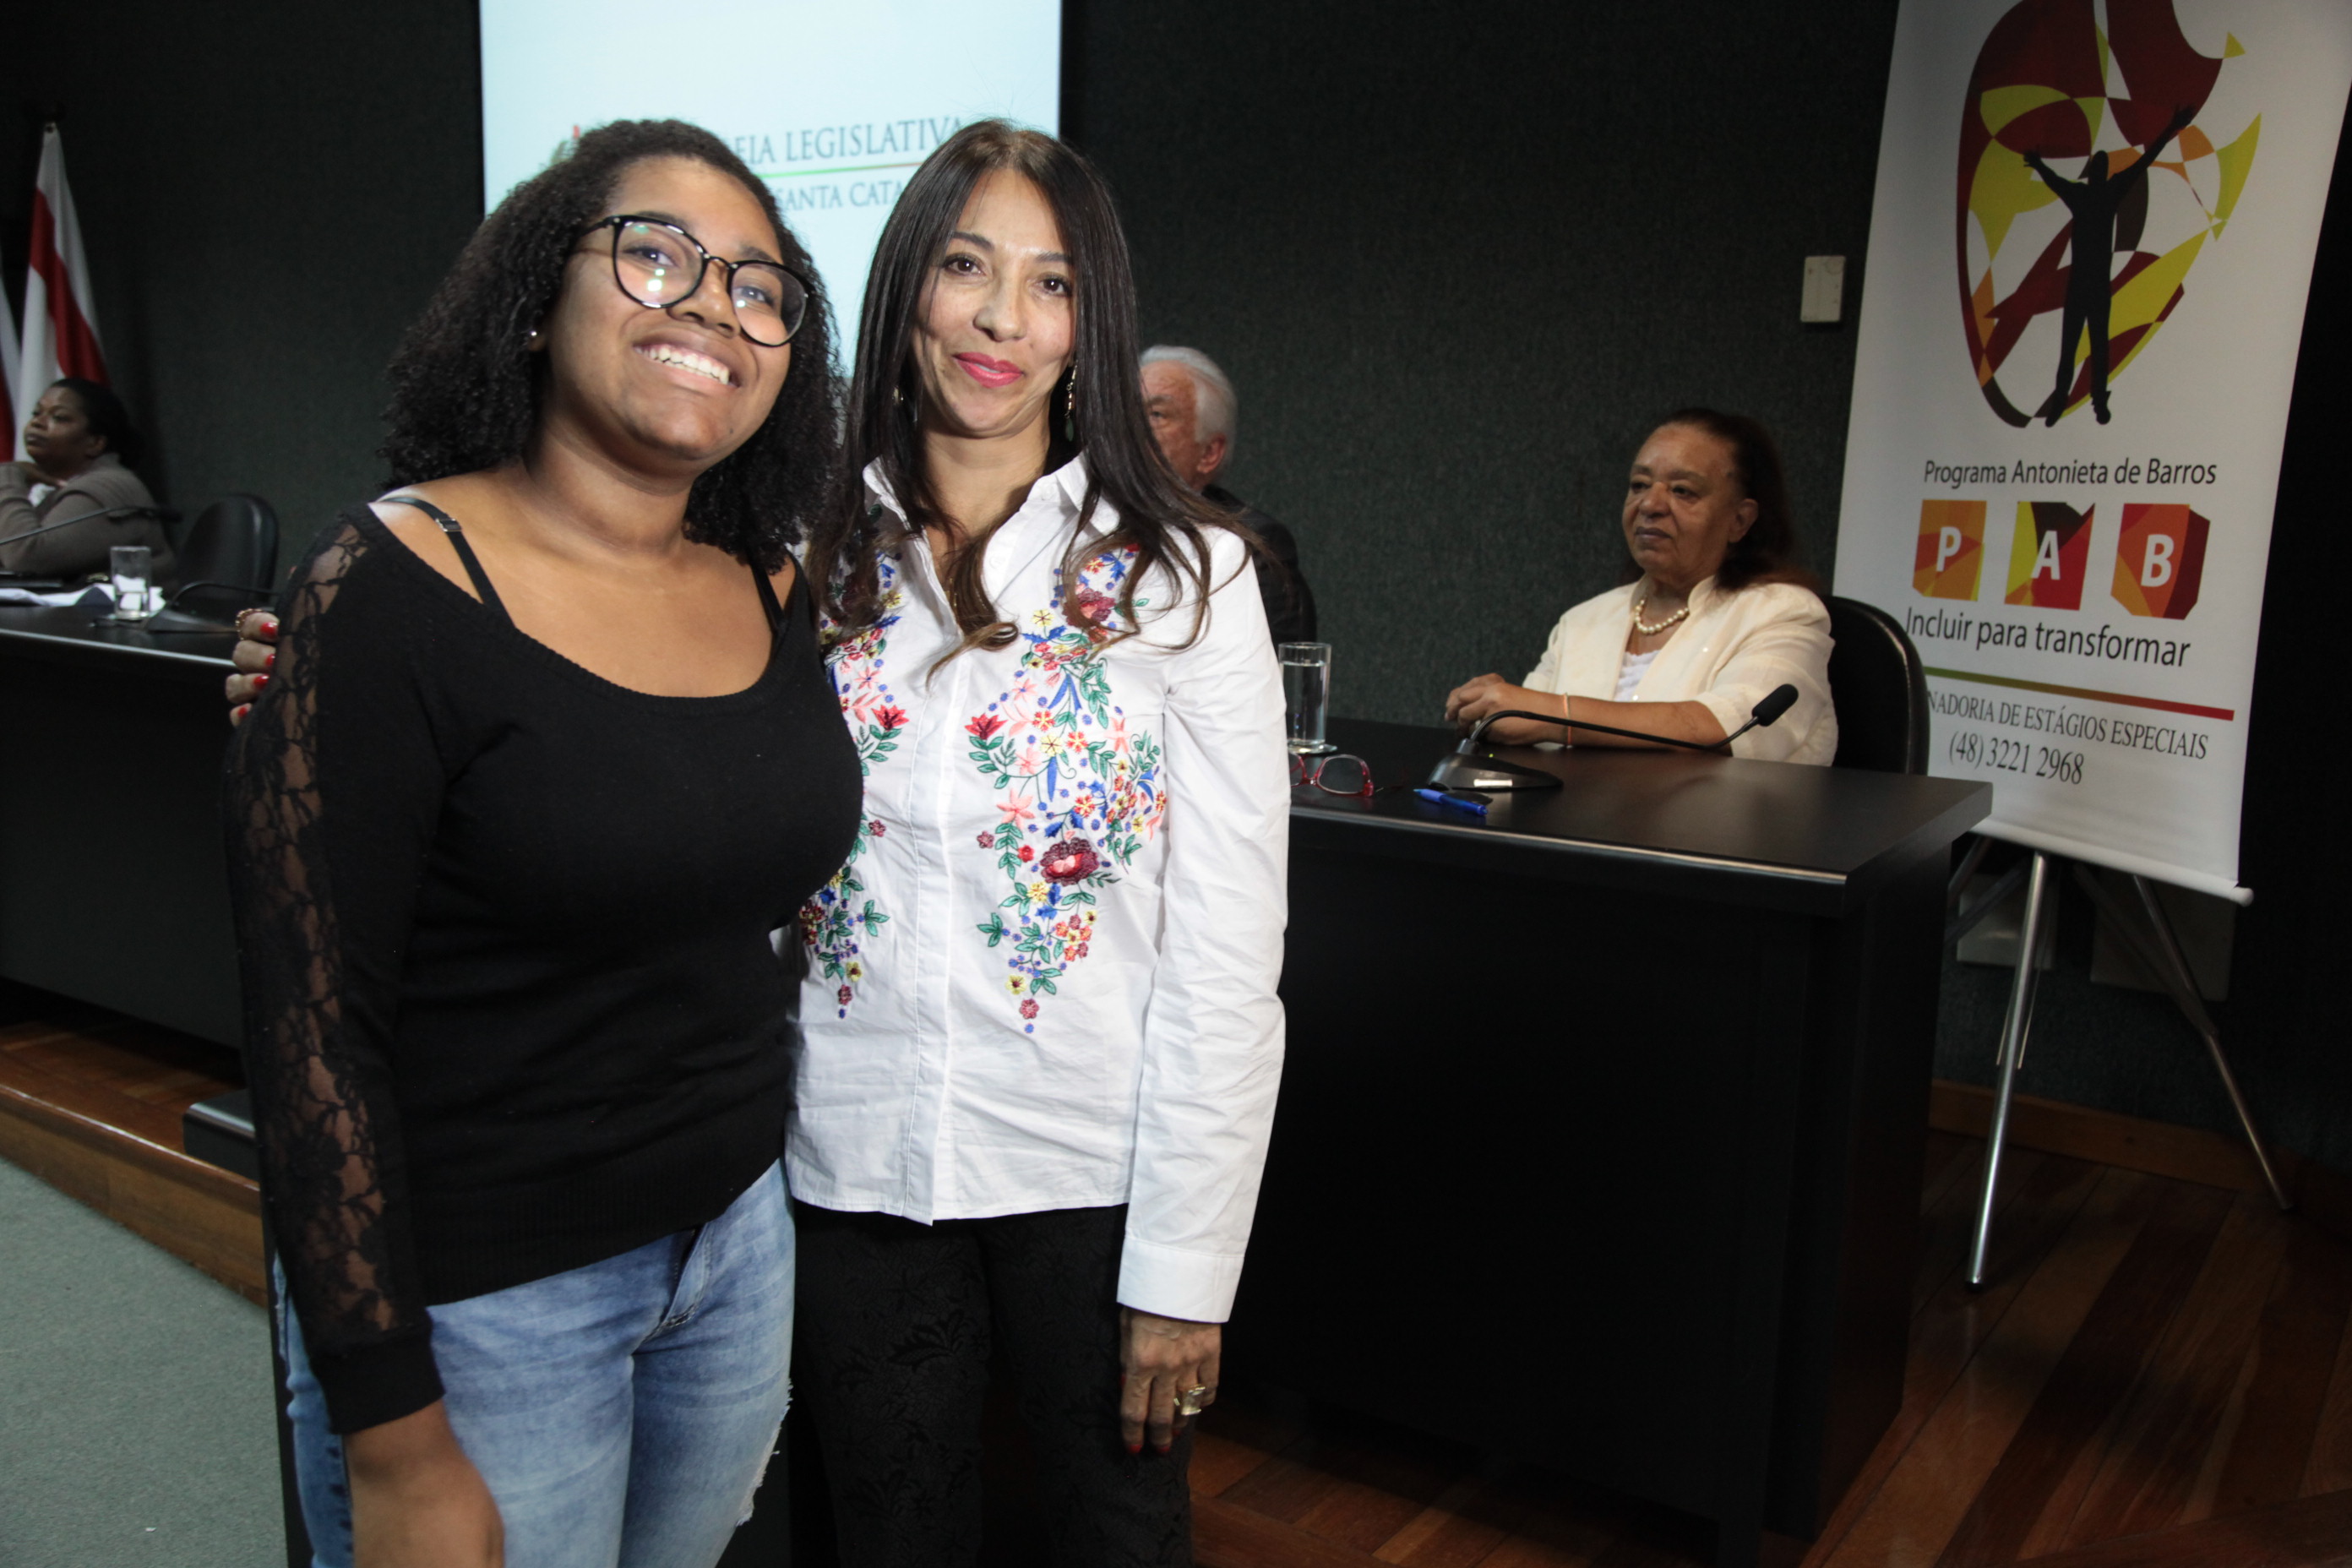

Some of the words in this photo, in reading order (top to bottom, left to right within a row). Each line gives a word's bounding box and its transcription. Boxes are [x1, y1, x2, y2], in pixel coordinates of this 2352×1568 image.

[733, 133, 776, 165] EIA
[848, 179, 904, 208] CATA
[1924, 460, 2007, 489] Programa
[2012, 459, 2108, 485] Antonieta
[2114, 457, 2141, 484] de
[2146, 457, 2218, 485] Barros
[1936, 525, 1963, 573] P
[2030, 530, 2061, 581] A
[2140, 533, 2175, 588] B
[1906, 606, 1974, 642] Incluir
[1975, 621, 2028, 651] para
[2034, 622, 2191, 667] transformar
[1926, 689, 1995, 723] NADORIA
[1999, 701, 2022, 728] DE
[2023, 705, 2108, 743] ESTÁGIOS
[2110, 720, 2209, 760] ESPECIAIS
[1949, 730, 1984, 770] (48)
[1986, 737, 2031, 774] 3221
[2035, 746, 2085, 785] 2968
